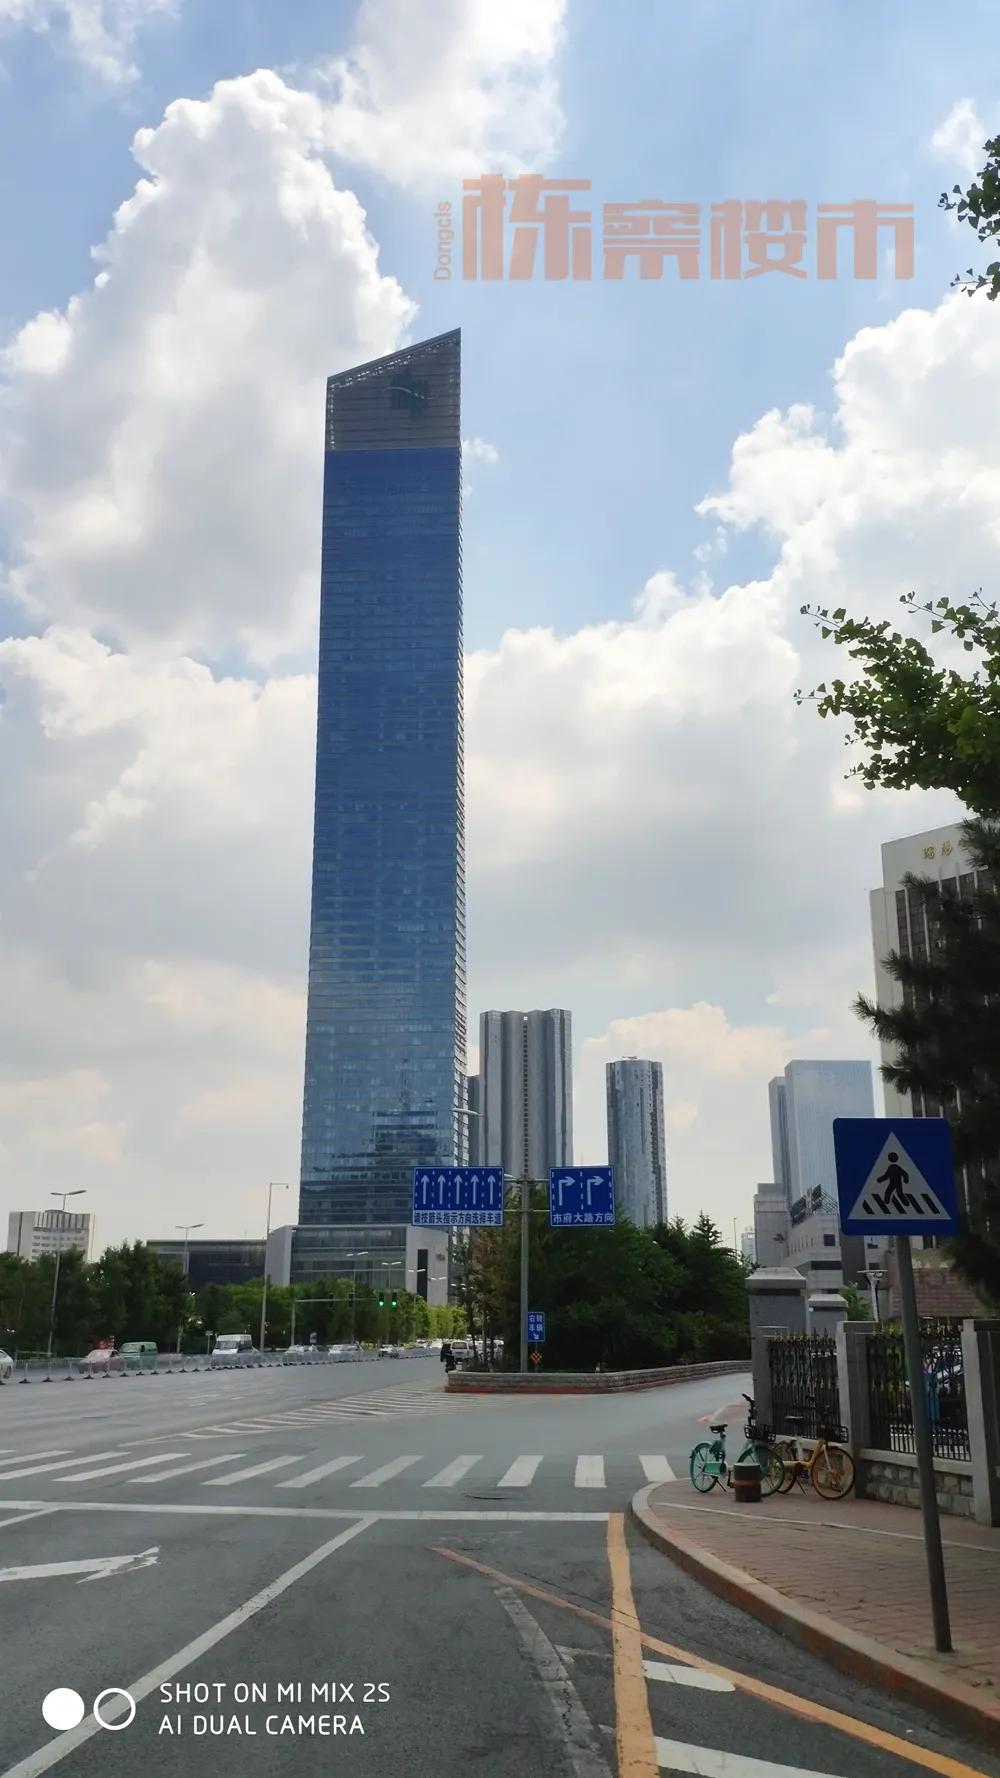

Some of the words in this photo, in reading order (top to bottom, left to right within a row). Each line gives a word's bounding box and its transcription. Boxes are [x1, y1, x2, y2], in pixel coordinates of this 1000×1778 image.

[552, 1211, 614, 1224] 市府大路方向
